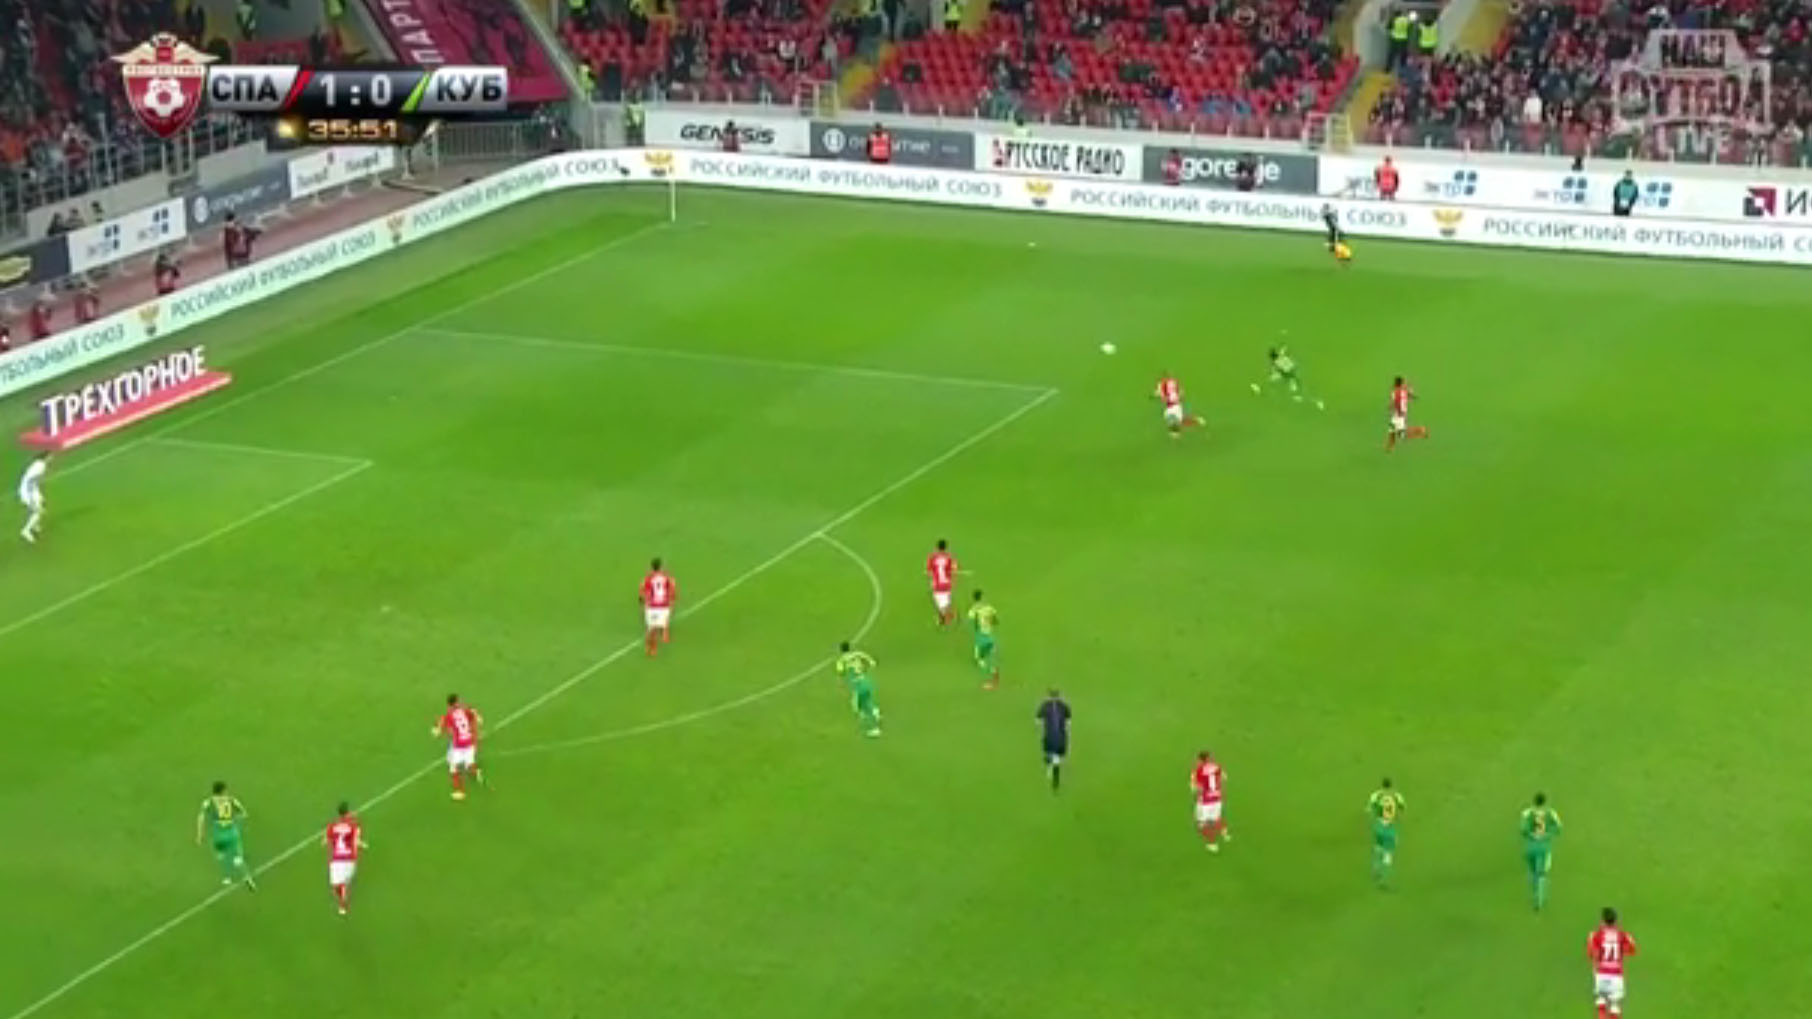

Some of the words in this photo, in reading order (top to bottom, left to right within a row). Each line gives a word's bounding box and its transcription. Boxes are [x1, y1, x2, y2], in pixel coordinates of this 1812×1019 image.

[690, 158, 811, 183] РОССИЙСКИЙ
[818, 169, 939, 194] ФУТБОЛЬНЫЙ
[947, 178, 1002, 198] СОЮЗ
[1070, 187, 1201, 212] РОССИЙСКИЙ
[1347, 207, 1407, 226] СОЮЗ
[1483, 217, 1627, 243] РОССИЙСКИЙ
[1634, 226, 1785, 251] ФУТБОЛЬНЫЙ
